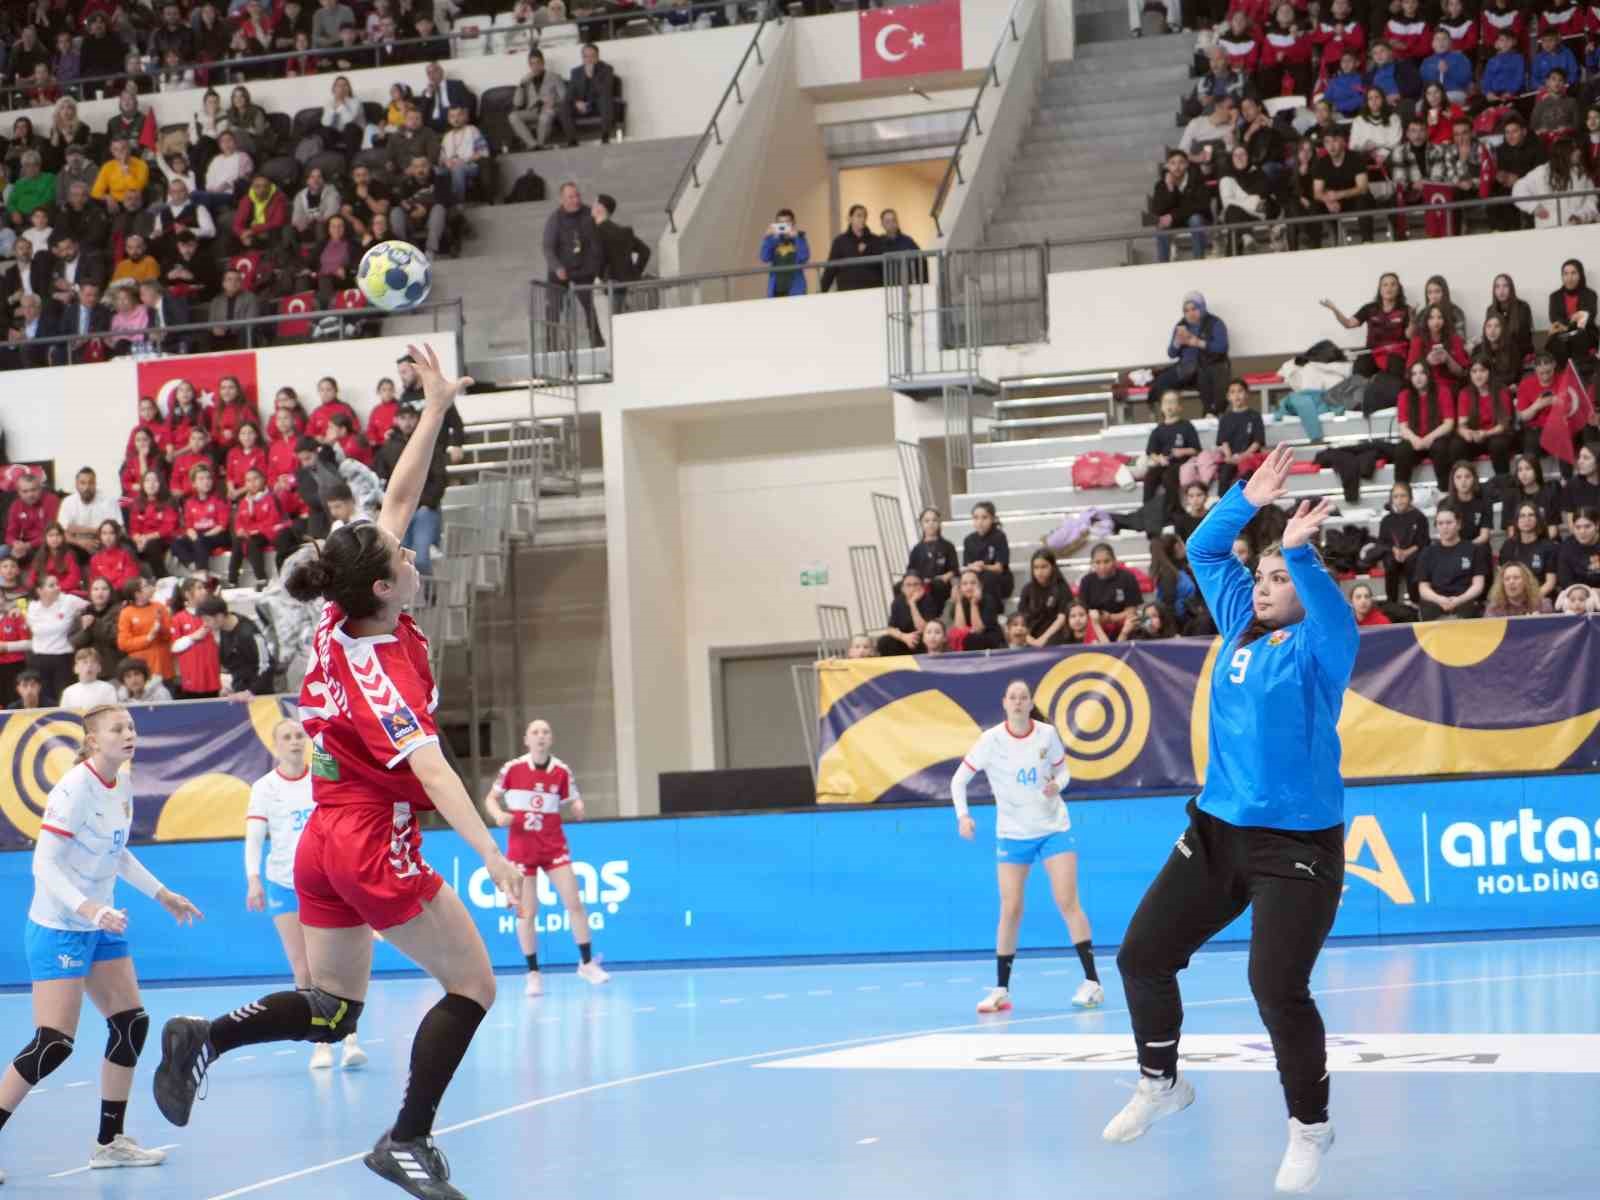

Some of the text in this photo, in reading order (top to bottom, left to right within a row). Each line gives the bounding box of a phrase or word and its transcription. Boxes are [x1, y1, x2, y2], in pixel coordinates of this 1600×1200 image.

[1229, 648, 1252, 684] 9
[1016, 767, 1037, 784] 44
[1440, 808, 1600, 868] arta
[499, 909, 605, 934] HLDİG
